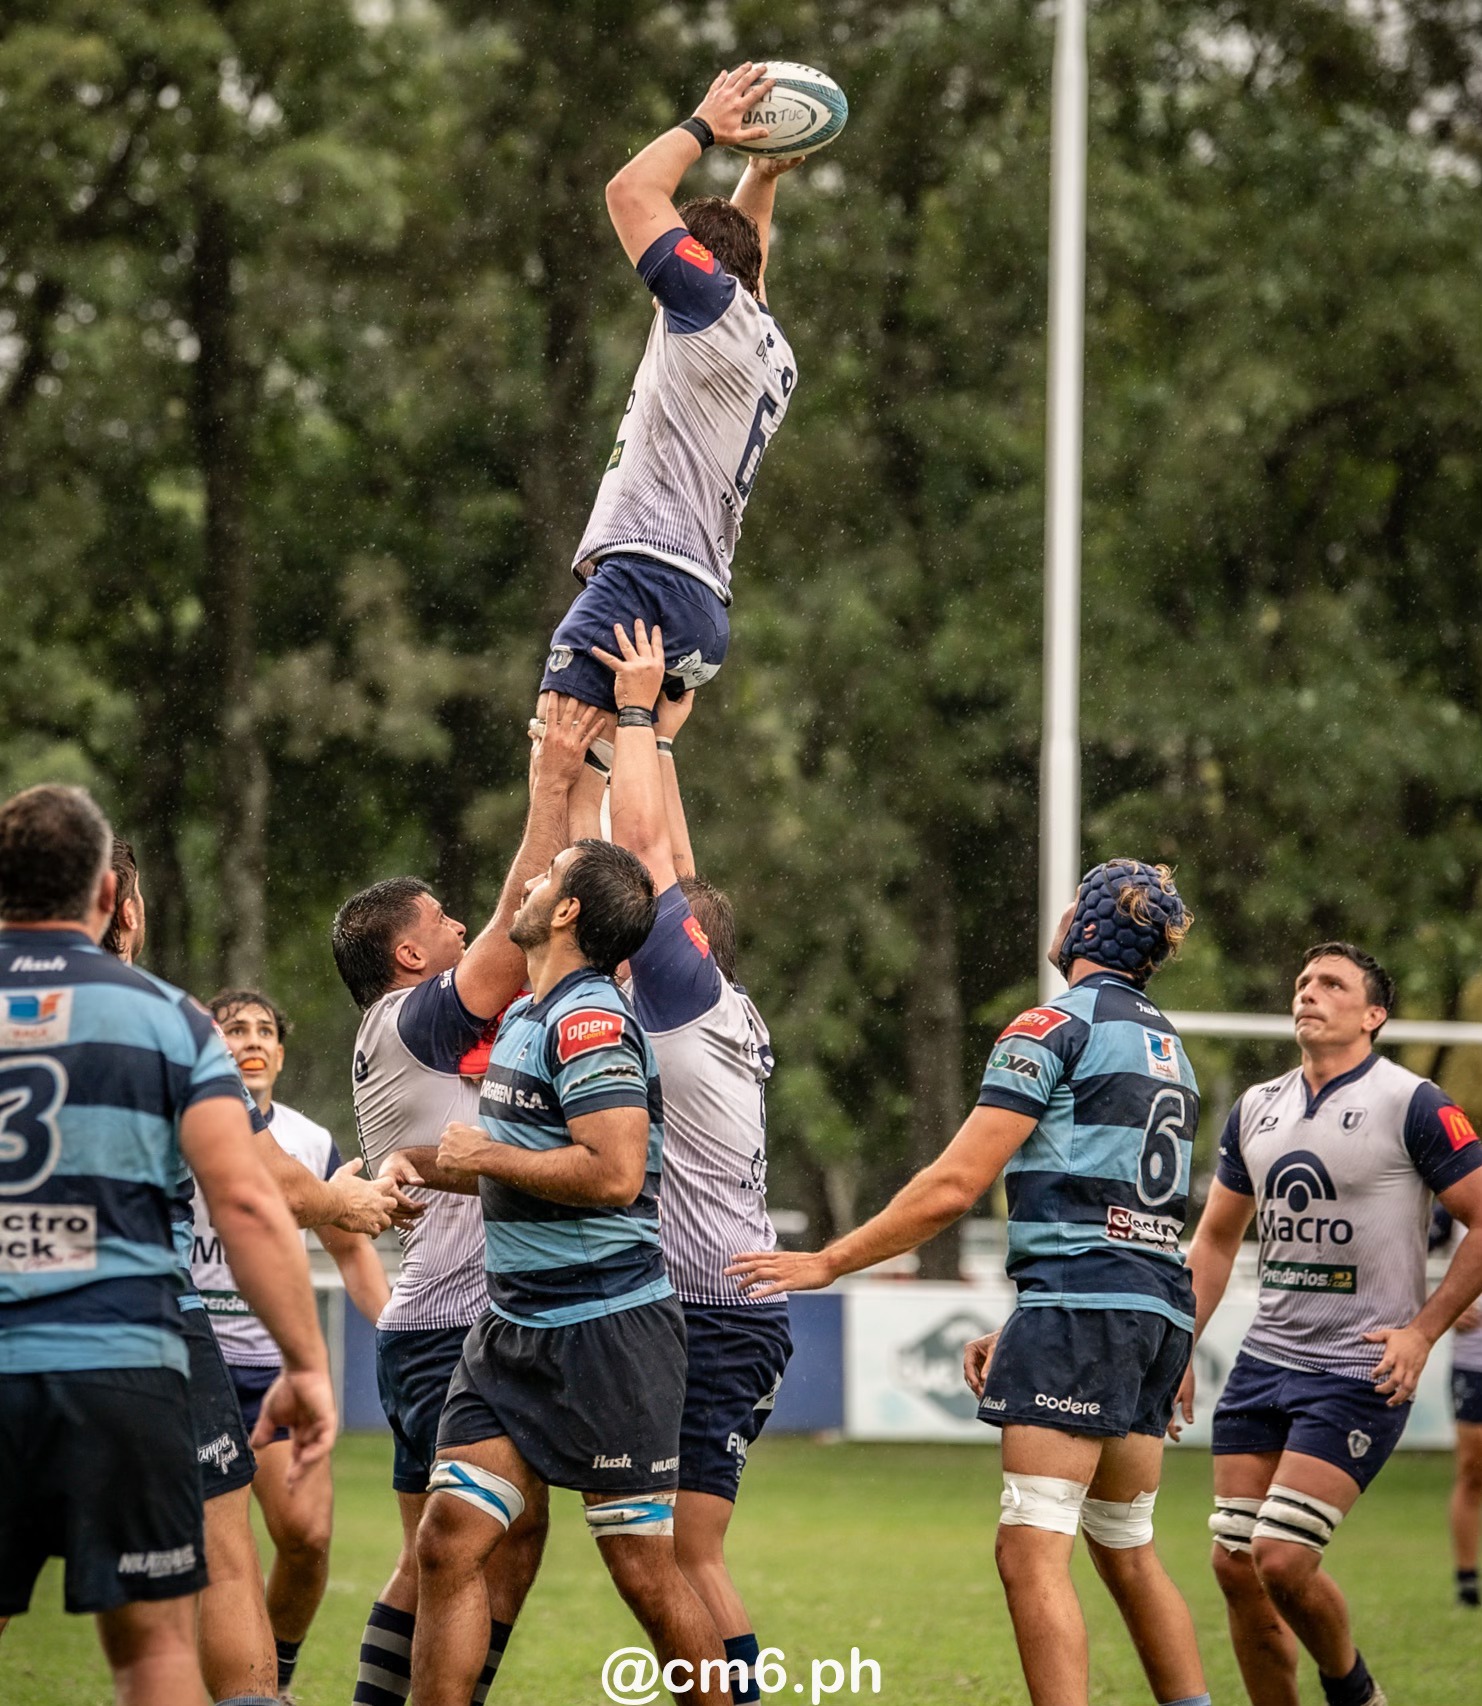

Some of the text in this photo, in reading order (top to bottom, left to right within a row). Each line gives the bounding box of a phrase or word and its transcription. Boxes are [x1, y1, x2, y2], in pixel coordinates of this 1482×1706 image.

[778, 108, 803, 122] TUC
[1010, 1012, 1050, 1026] pen
[567, 1020, 613, 1041] open
[514, 1089, 549, 1111] S.A.
[1136, 1089, 1185, 1207] 6
[1260, 1209, 1353, 1246] Macro
[0, 1238, 55, 1260] ck
[1035, 1393, 1101, 1415] codere
[592, 1453, 632, 1469] flash
